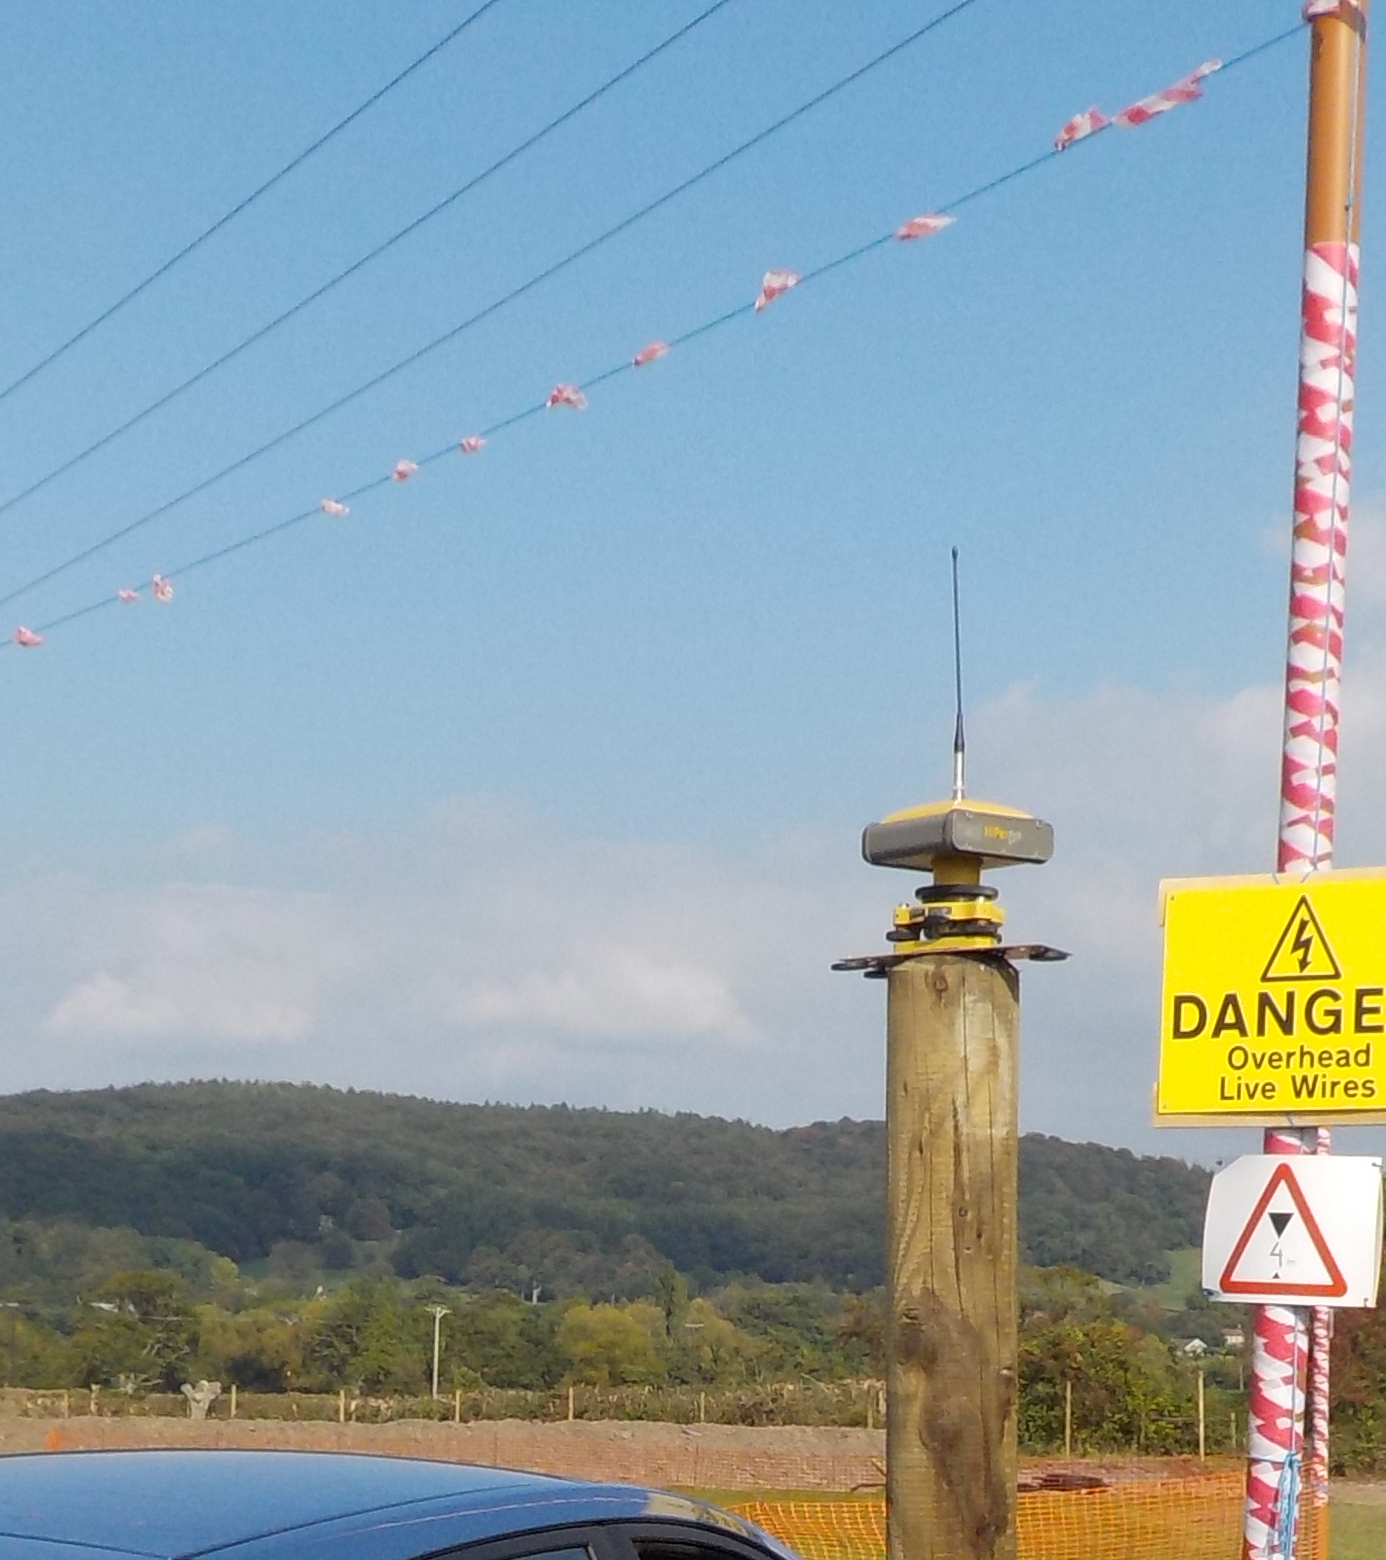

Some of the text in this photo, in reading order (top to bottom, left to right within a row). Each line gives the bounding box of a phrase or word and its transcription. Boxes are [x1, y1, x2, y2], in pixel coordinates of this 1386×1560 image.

[1227, 1043, 1371, 1070] Overhead
[1219, 1073, 1377, 1101] Live Wires
[1269, 1241, 1283, 1268] 4
